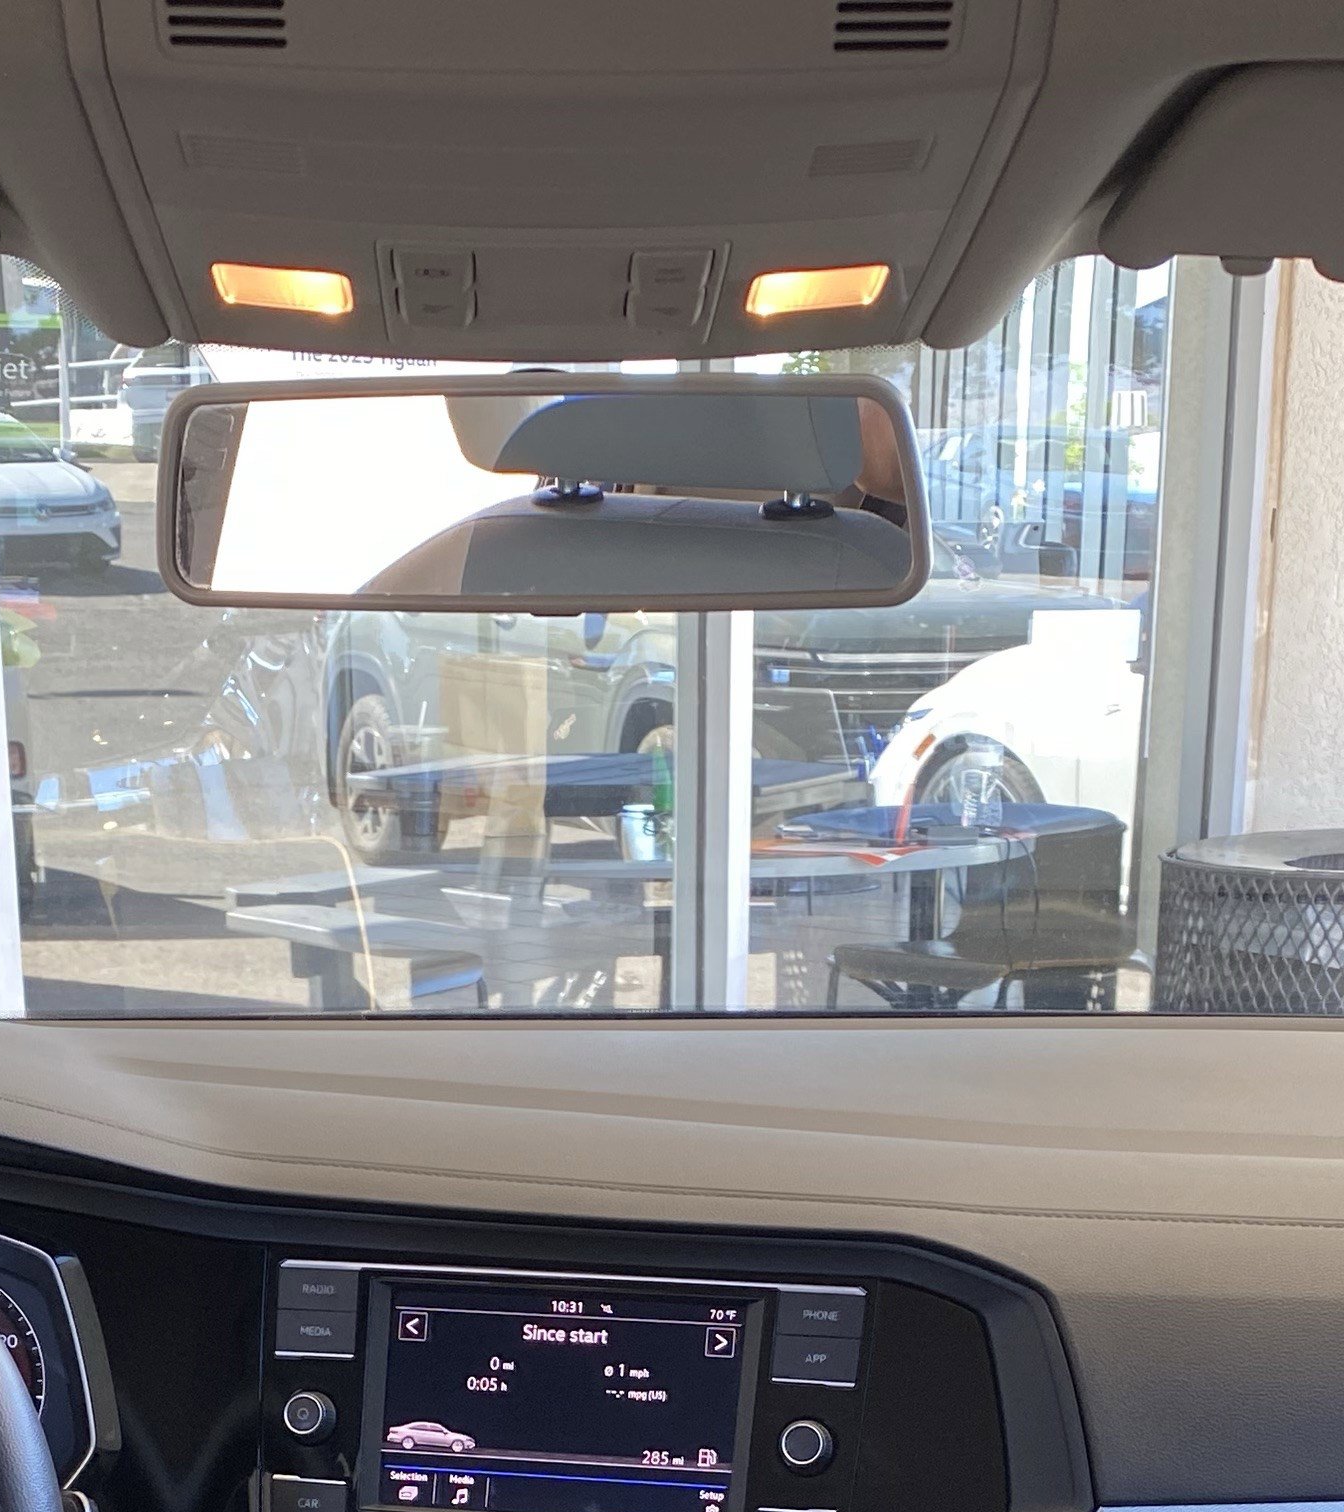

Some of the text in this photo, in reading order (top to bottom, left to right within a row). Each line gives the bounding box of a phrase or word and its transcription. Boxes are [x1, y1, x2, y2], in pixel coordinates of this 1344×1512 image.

[302, 1284, 335, 1295] RADIO
[551, 1300, 584, 1314] 10:31
[709, 1308, 724, 1321] 70
[802, 1309, 839, 1322] PHONE
[300, 1325, 332, 1337] MEDIA
[522, 1323, 608, 1345] Since start
[490, 1356, 500, 1371] 0
[805, 1353, 827, 1364] APP
[466, 1377, 498, 1392] 0:05
[641, 1450, 669, 1466] 285
[389, 1470, 428, 1482] Selection
[449, 1474, 475, 1485] Media
[699, 1490, 725, 1502] Setup
[297, 1498, 320, 1509] CAR
